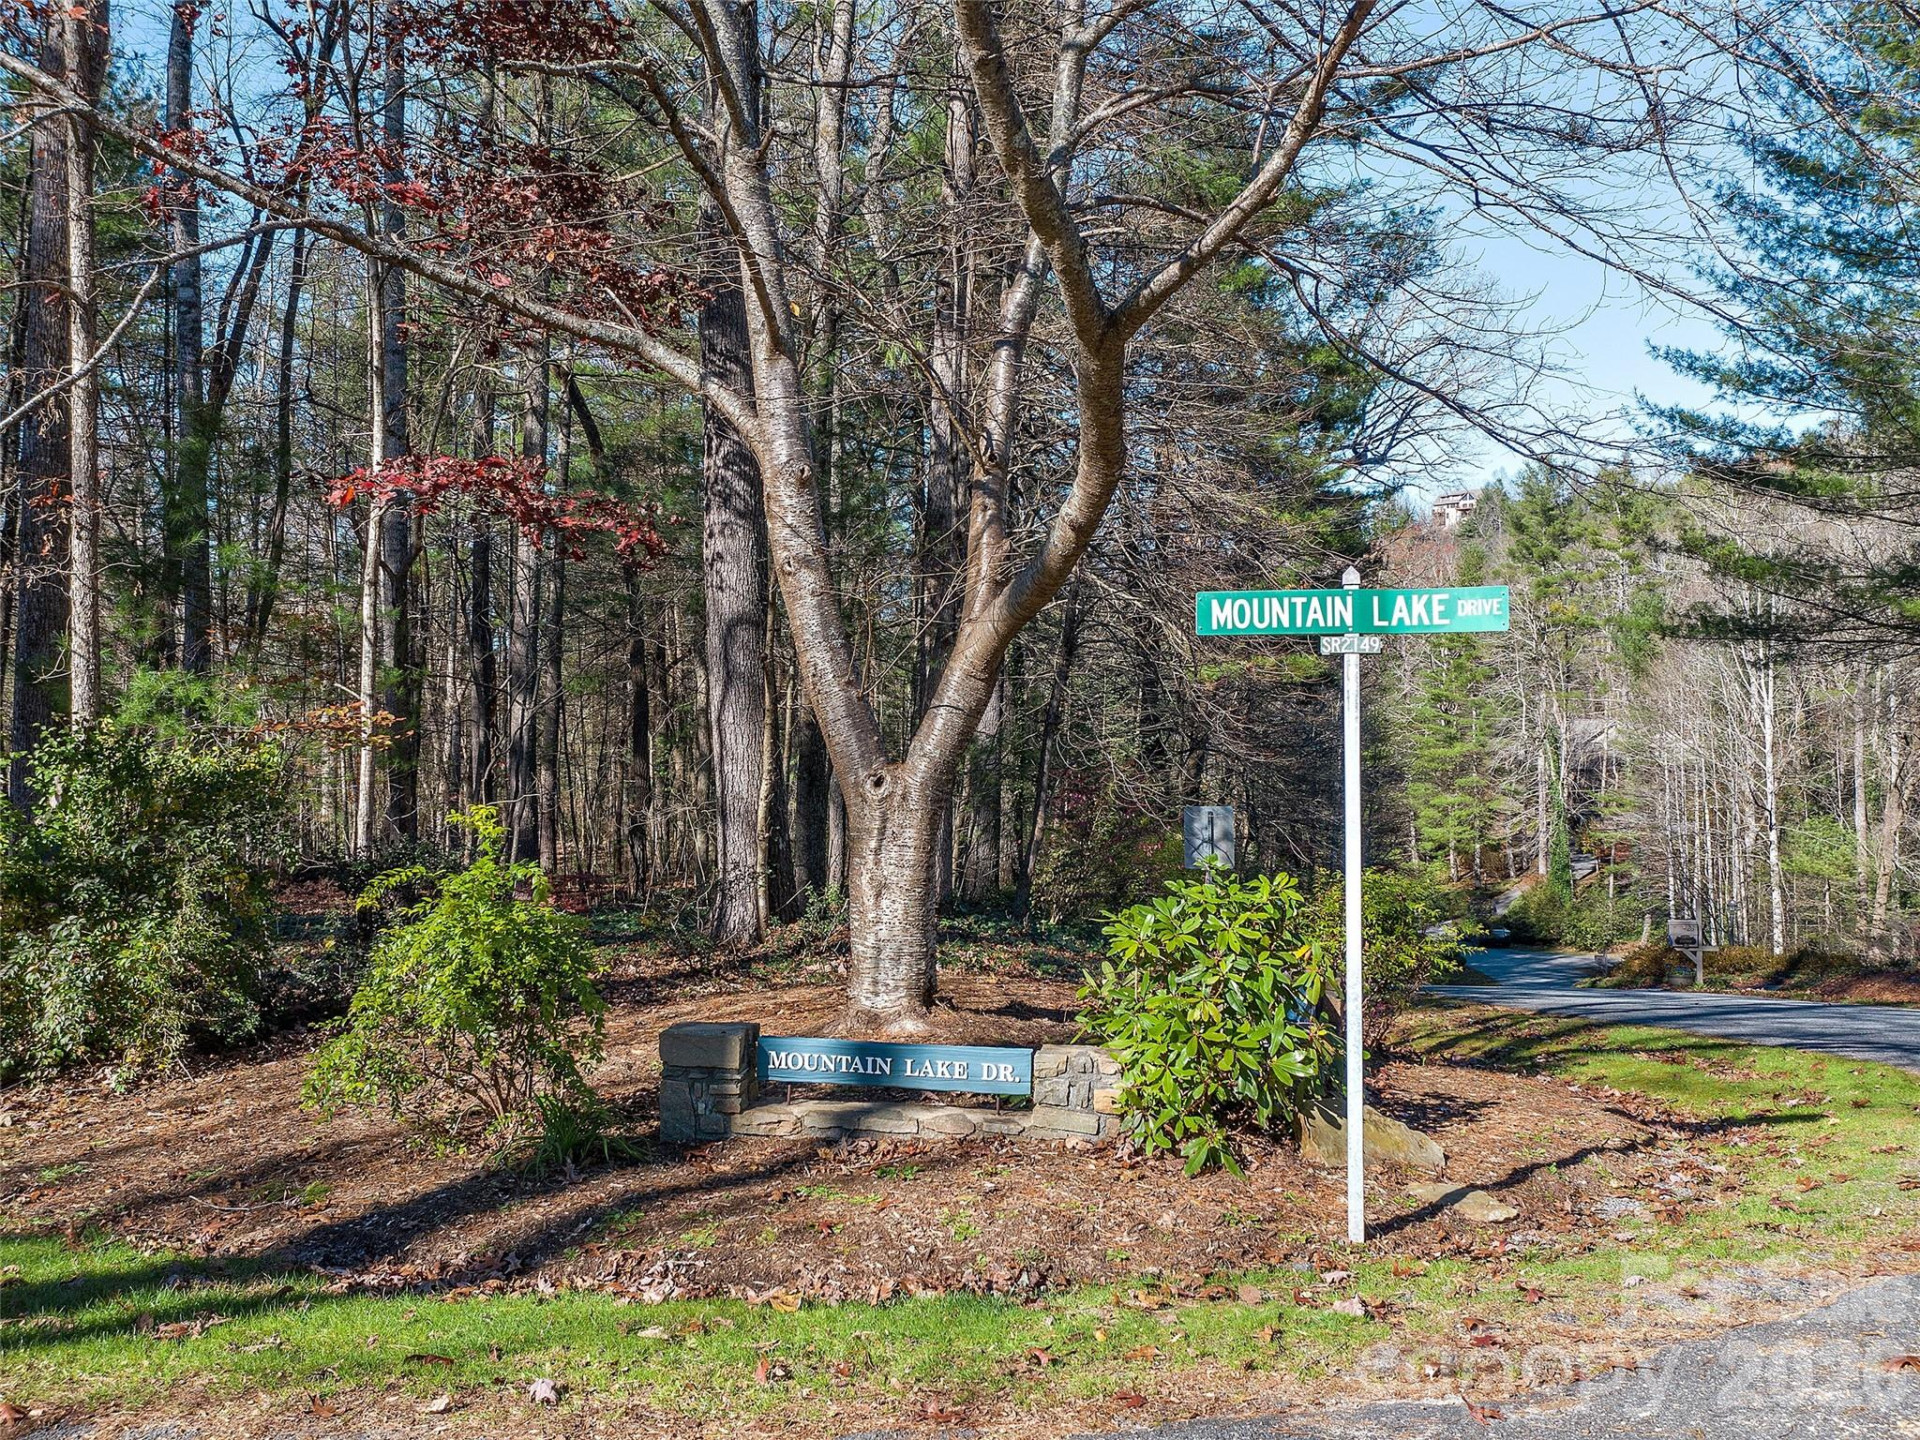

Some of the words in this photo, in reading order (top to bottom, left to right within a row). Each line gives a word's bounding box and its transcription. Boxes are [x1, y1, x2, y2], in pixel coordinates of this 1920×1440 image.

[1210, 594, 1353, 630] MOUNTAIN
[1373, 593, 1450, 627] LAKE
[1457, 597, 1502, 617] DRIVE
[1322, 636, 1380, 653] SR2149
[768, 1050, 892, 1075] MOUNTAIN
[904, 1058, 968, 1080] LAKE
[981, 1062, 1021, 1083] DR.
